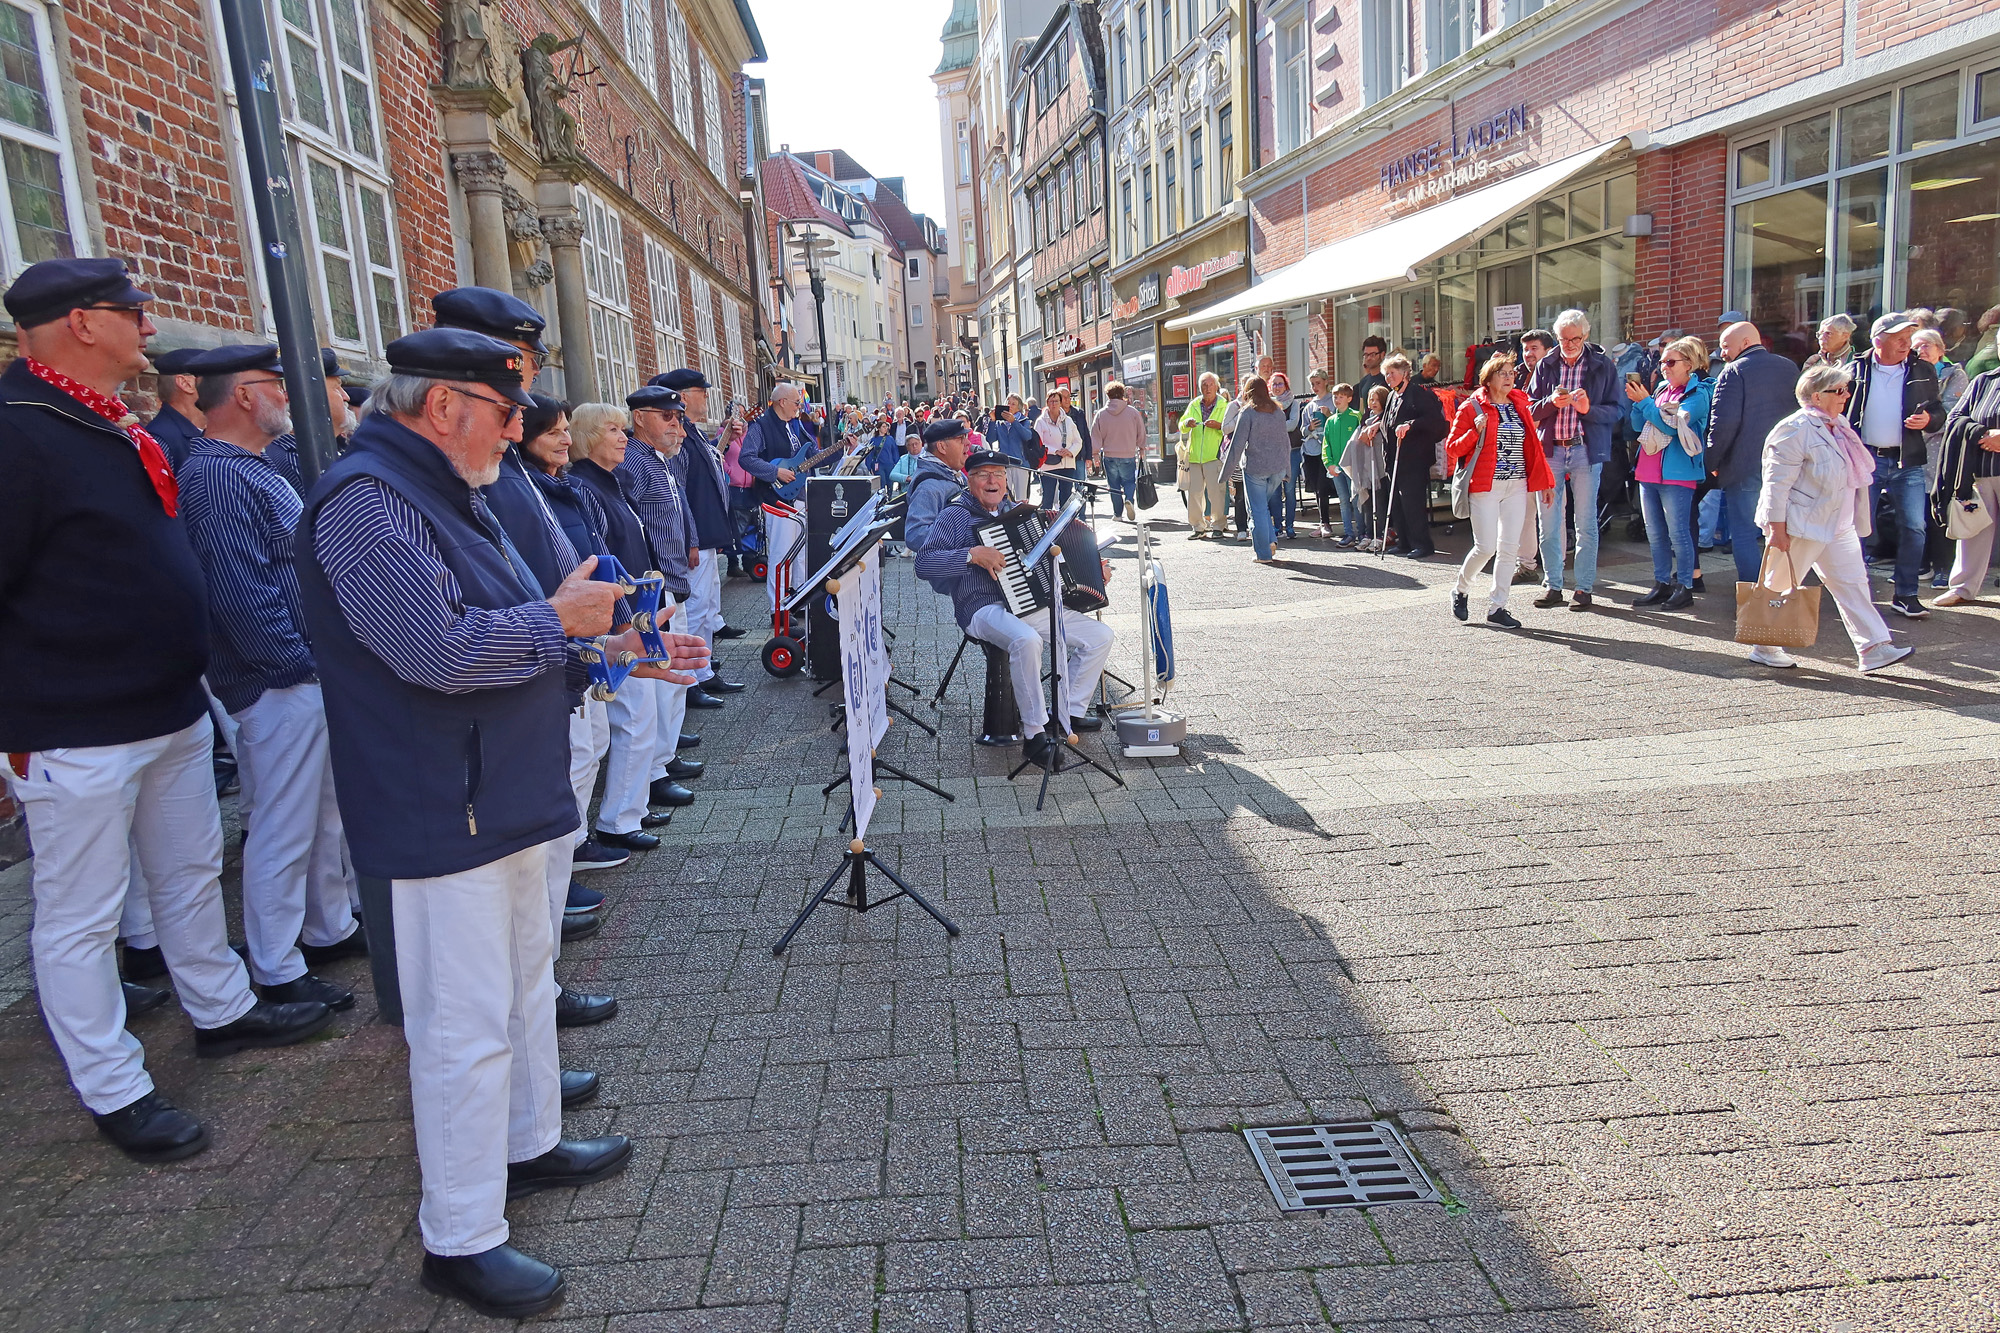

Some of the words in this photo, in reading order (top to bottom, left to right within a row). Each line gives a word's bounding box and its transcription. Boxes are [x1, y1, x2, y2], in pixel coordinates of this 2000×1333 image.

[1407, 183, 1425, 205] AM
[1427, 159, 1488, 198] RATHAUS
[1139, 282, 1157, 306] Shop
[1166, 263, 1203, 299] alltours
